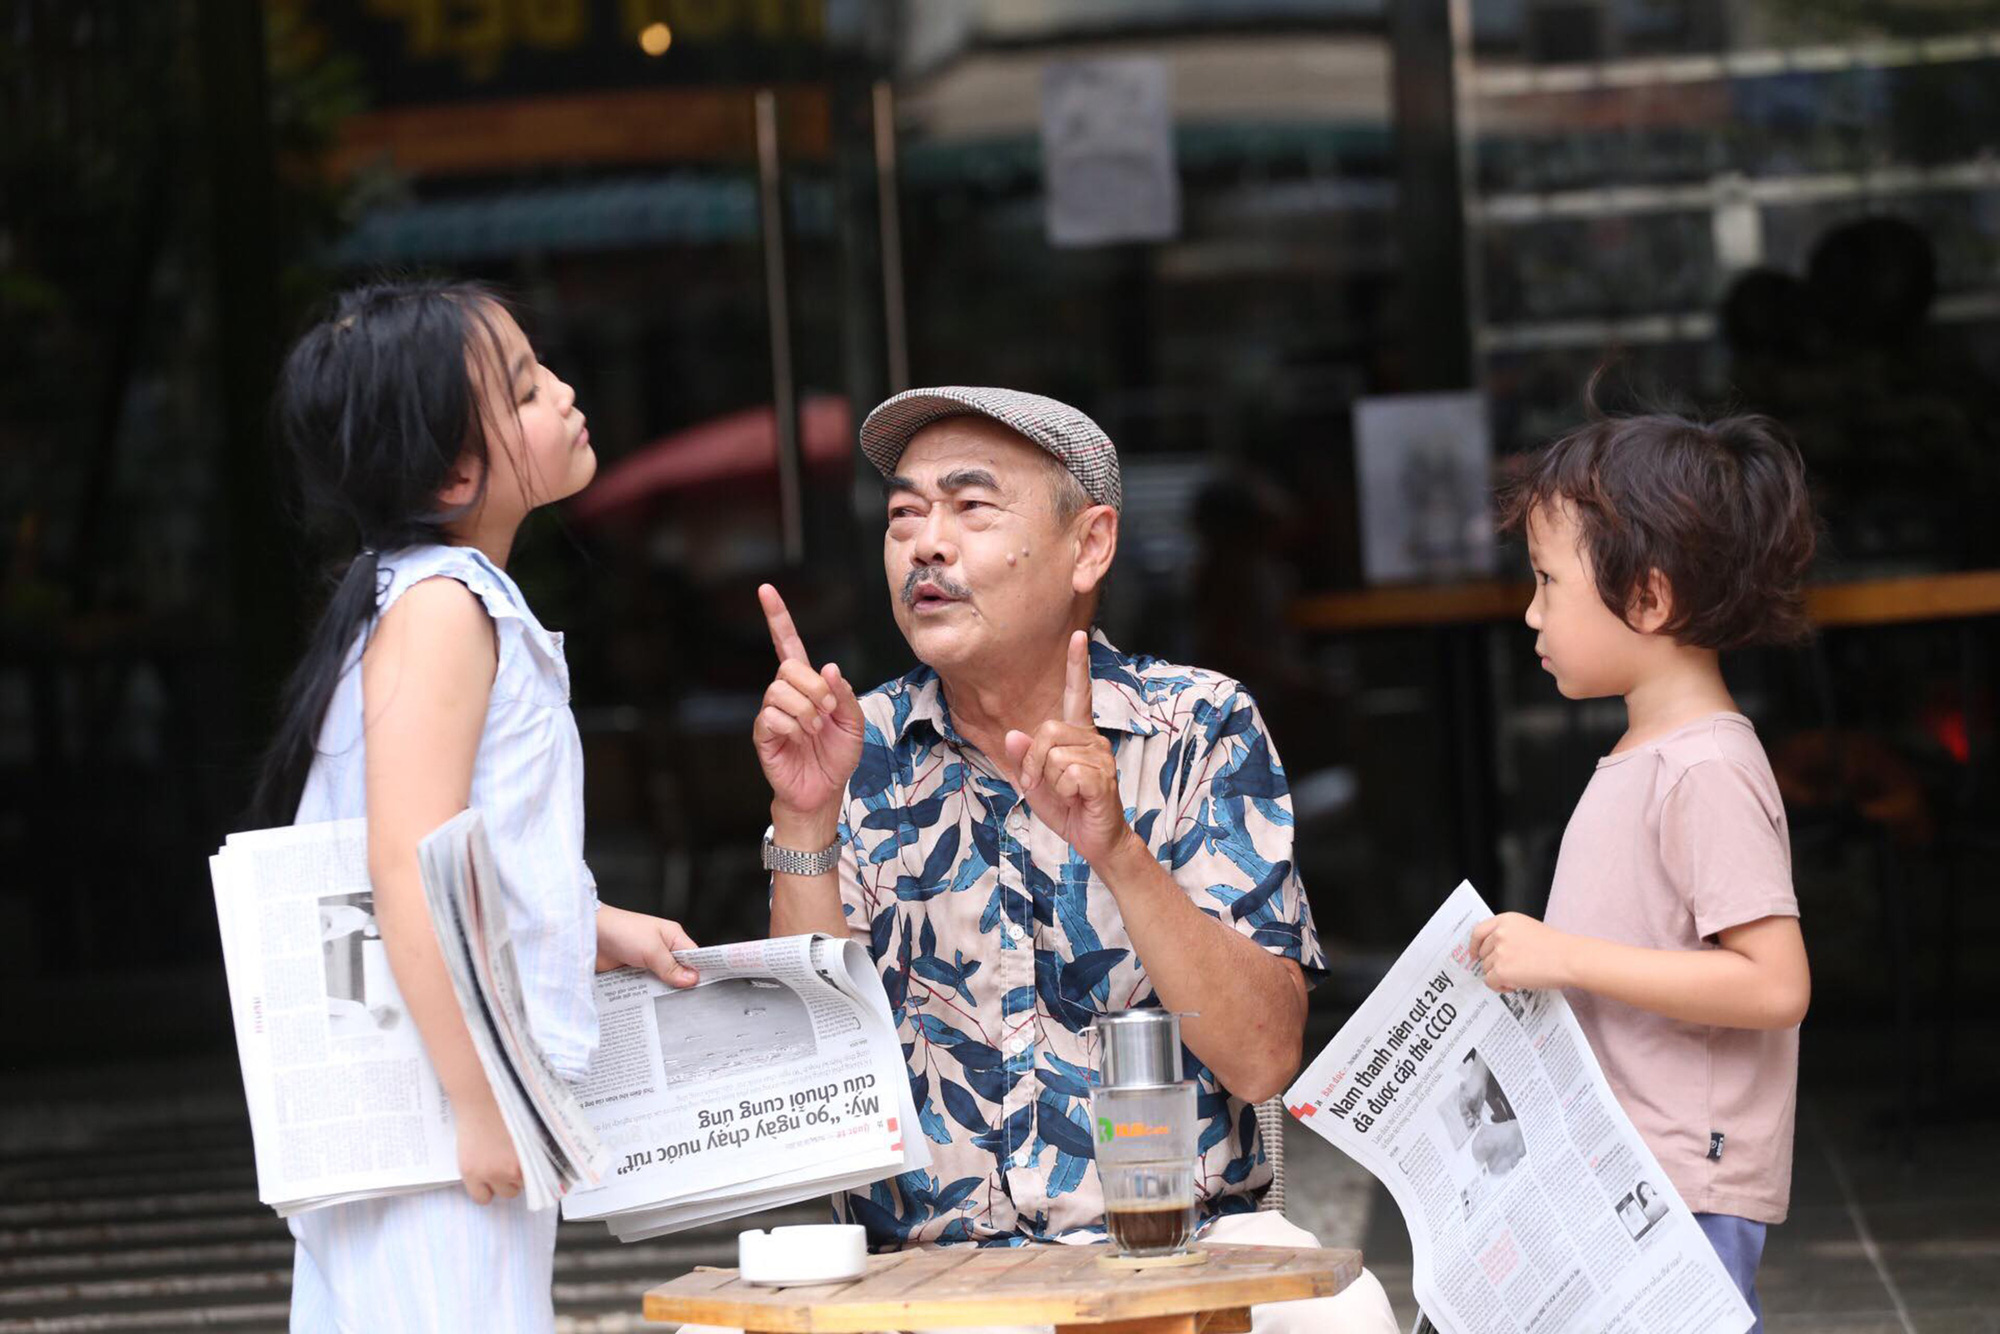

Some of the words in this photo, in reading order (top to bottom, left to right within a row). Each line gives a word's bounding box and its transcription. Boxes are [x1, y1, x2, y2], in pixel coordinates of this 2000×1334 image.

[1428, 970, 1454, 993] tay
[1424, 990, 1438, 1003] 2
[1409, 998, 1431, 1023] cụt
[1386, 1020, 1414, 1051] niên
[1352, 1111, 1375, 1133] đã
[1367, 1081, 1399, 1114] được
[1394, 1059, 1417, 1084] cấp
[1408, 1034, 1433, 1062] thẻ
[1425, 1003, 1457, 1040] CCCD
[1354, 1048, 1393, 1088] thanh
[789, 1084, 838, 1112] chuỗi
[843, 1074, 875, 1098] cứu
[739, 1097, 784, 1119] cung
[802, 1102, 840, 1125] “90
[845, 1093, 879, 1117] Mỹ:
[1329, 1087, 1363, 1119] Nam
[698, 1109, 734, 1129] ứng
[755, 1110, 800, 1139] ngày
[707, 1126, 750, 1150] chạy
[617, 1151, 652, 1175] rút”
[656, 1139, 701, 1164] nước
